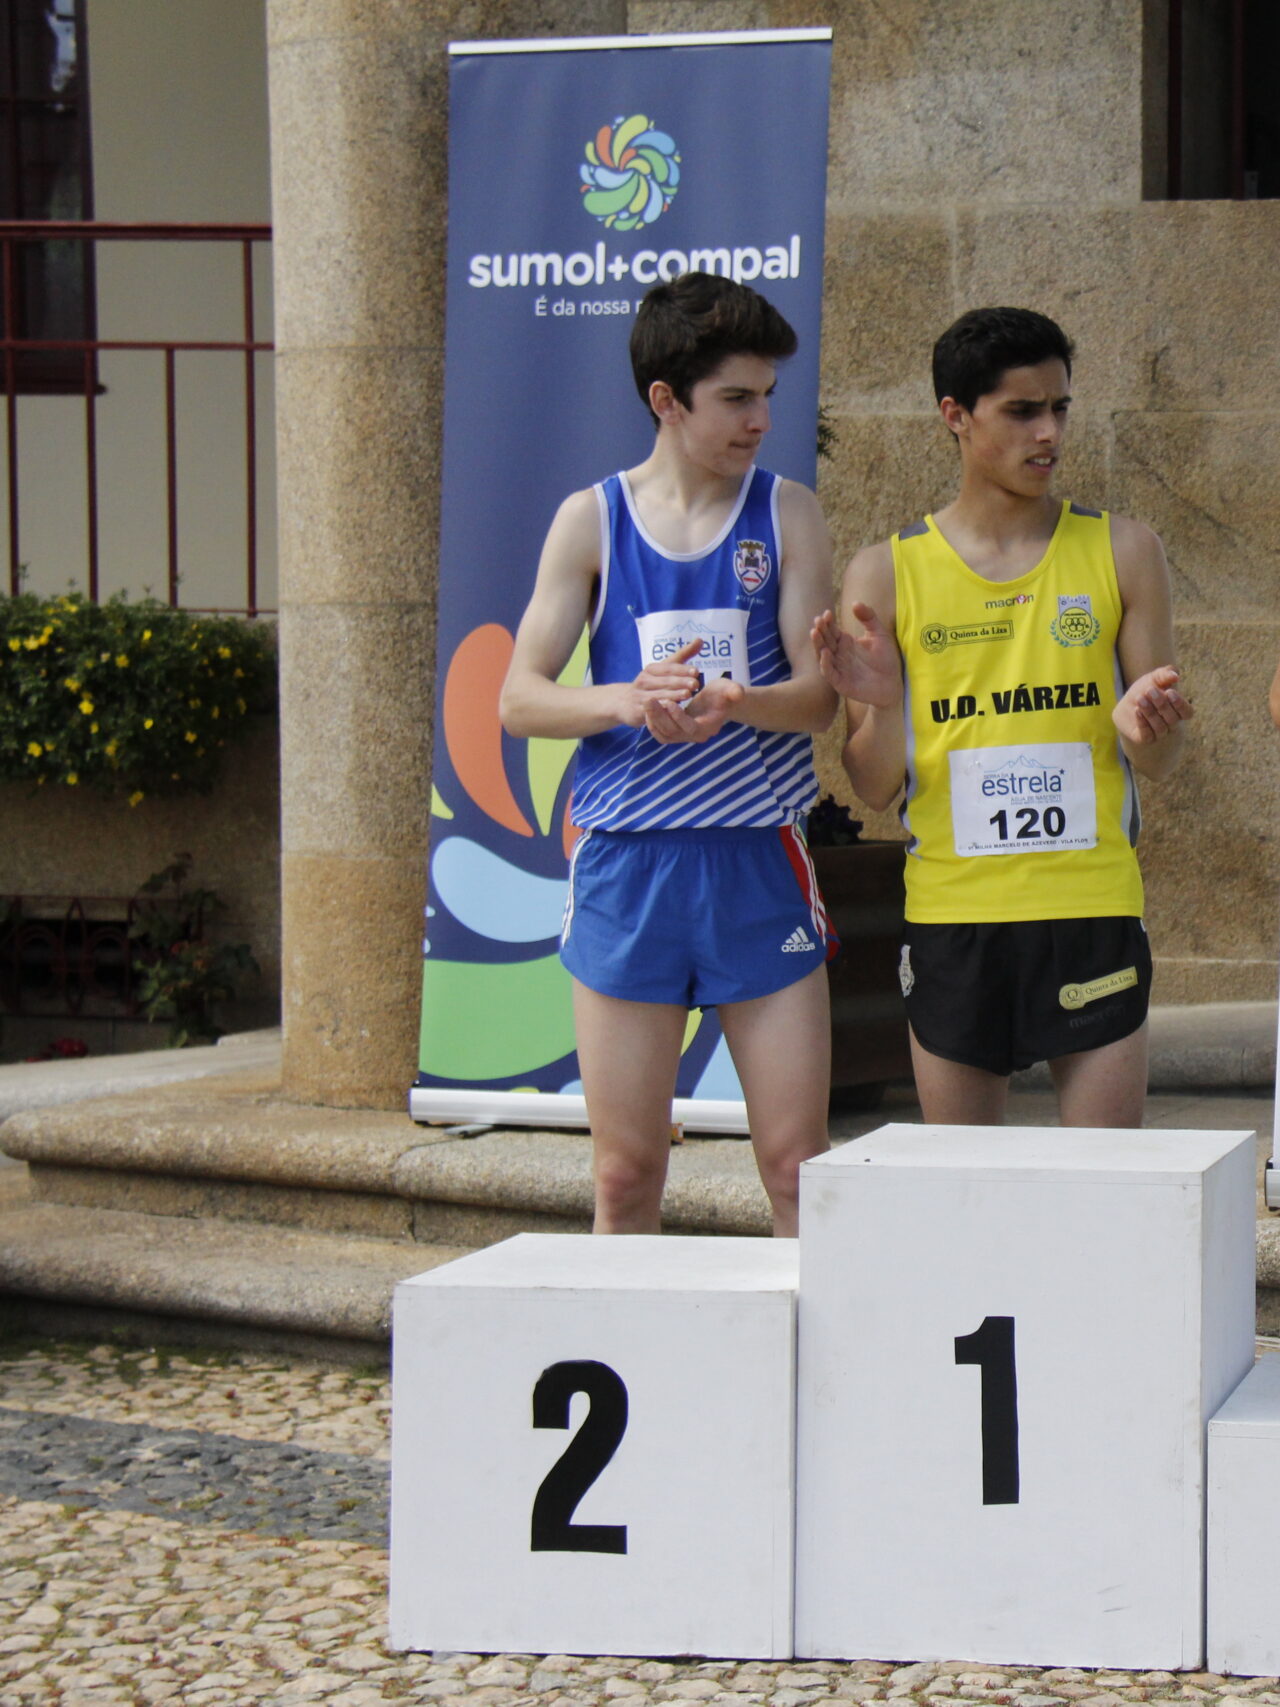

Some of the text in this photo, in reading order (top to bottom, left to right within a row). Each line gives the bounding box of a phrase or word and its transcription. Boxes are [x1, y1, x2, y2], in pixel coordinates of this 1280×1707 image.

[467, 234, 800, 288] sumol+compal
[535, 294, 547, 316] É
[553, 298, 575, 316] da
[580, 300, 630, 316] nossa
[985, 594, 1034, 610] macron
[950, 630, 978, 641] Quinta
[980, 628, 990, 636] da
[991, 626, 1008, 635] Lixa
[652, 635, 732, 661] estela
[930, 682, 1101, 723] U.D. VÁRZEA
[981, 771, 1062, 796] estrela
[989, 806, 1066, 841] 120
[781, 942, 816, 953] adidas
[954, 1315, 1021, 1507] 1
[529, 1358, 630, 1556] 2
